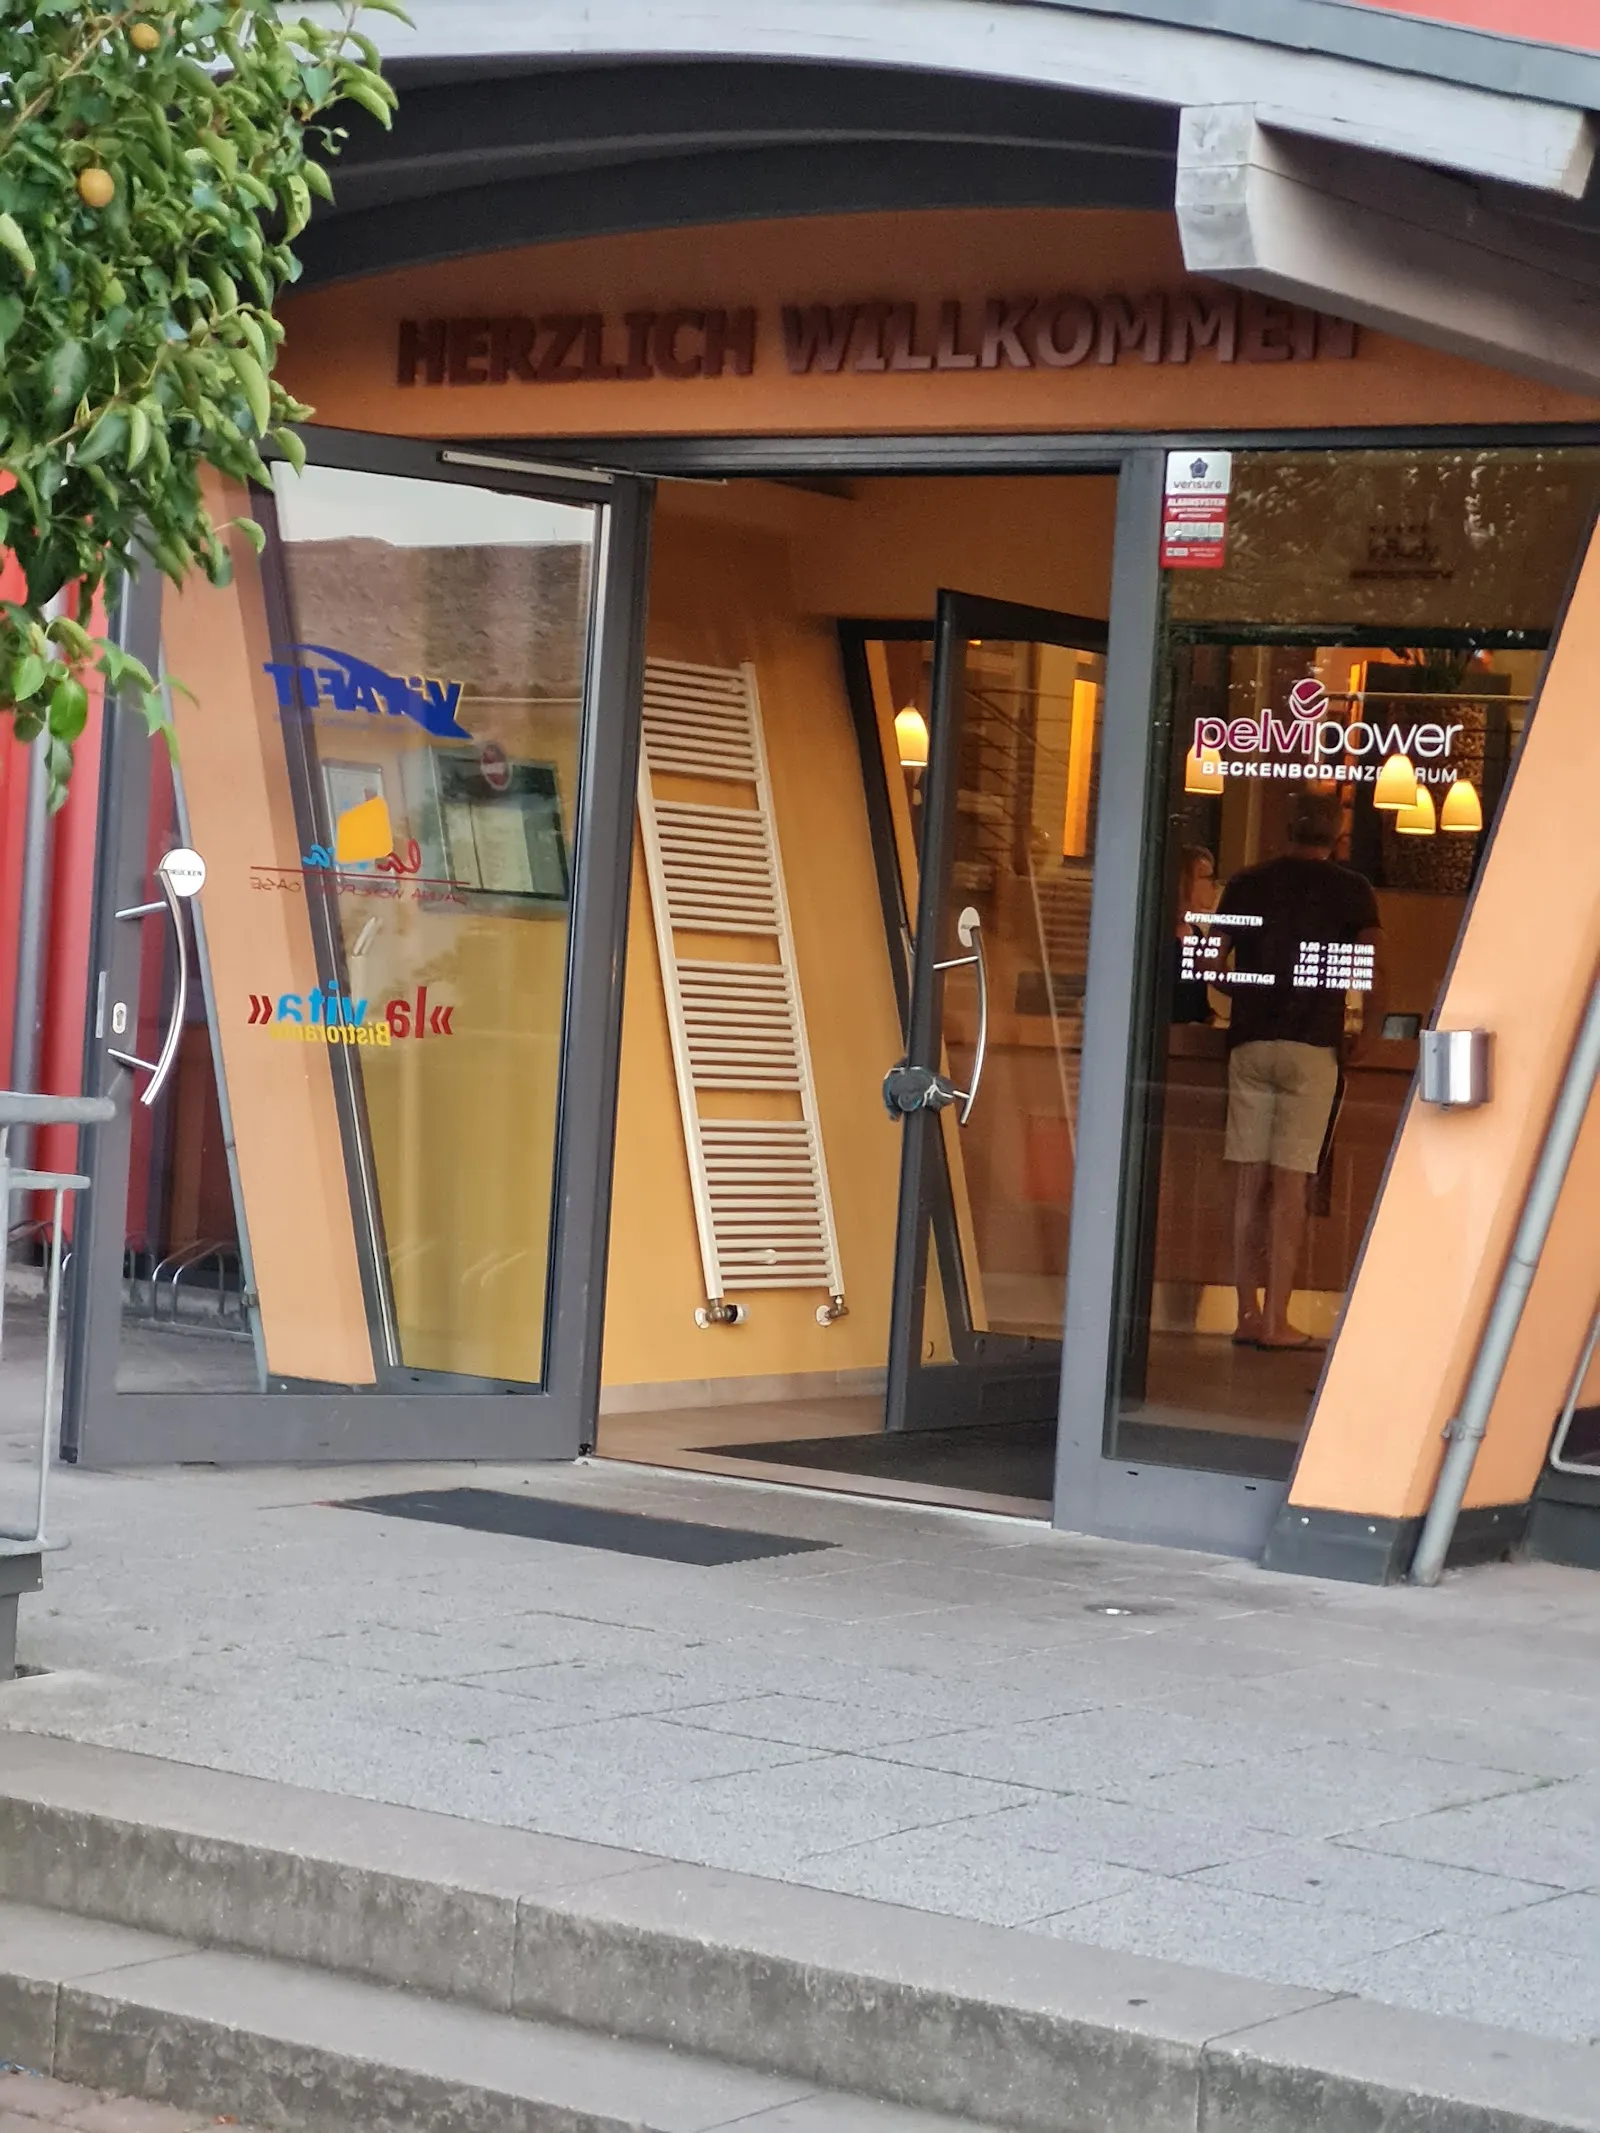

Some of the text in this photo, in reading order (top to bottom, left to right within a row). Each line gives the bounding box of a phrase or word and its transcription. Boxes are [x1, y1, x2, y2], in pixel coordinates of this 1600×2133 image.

[395, 290, 1359, 387] HERZLICH WILLKOMMEN
[1173, 480, 1222, 489] verisure
[1193, 709, 1464, 763] pelvipower
[1201, 760, 1459, 784] BECKENBODENZRUM
[1183, 936, 1221, 946] MO MI
[1204, 948, 1218, 958] DO
[1354, 945, 1375, 955] UHR
[1182, 958, 1194, 968] FR
[1353, 956, 1374, 967] UHR
[1181, 970, 1193, 979] SA
[1203, 971, 1216, 980] SO
[1353, 968, 1373, 978] UHR
[1352, 979, 1372, 990] UHR
